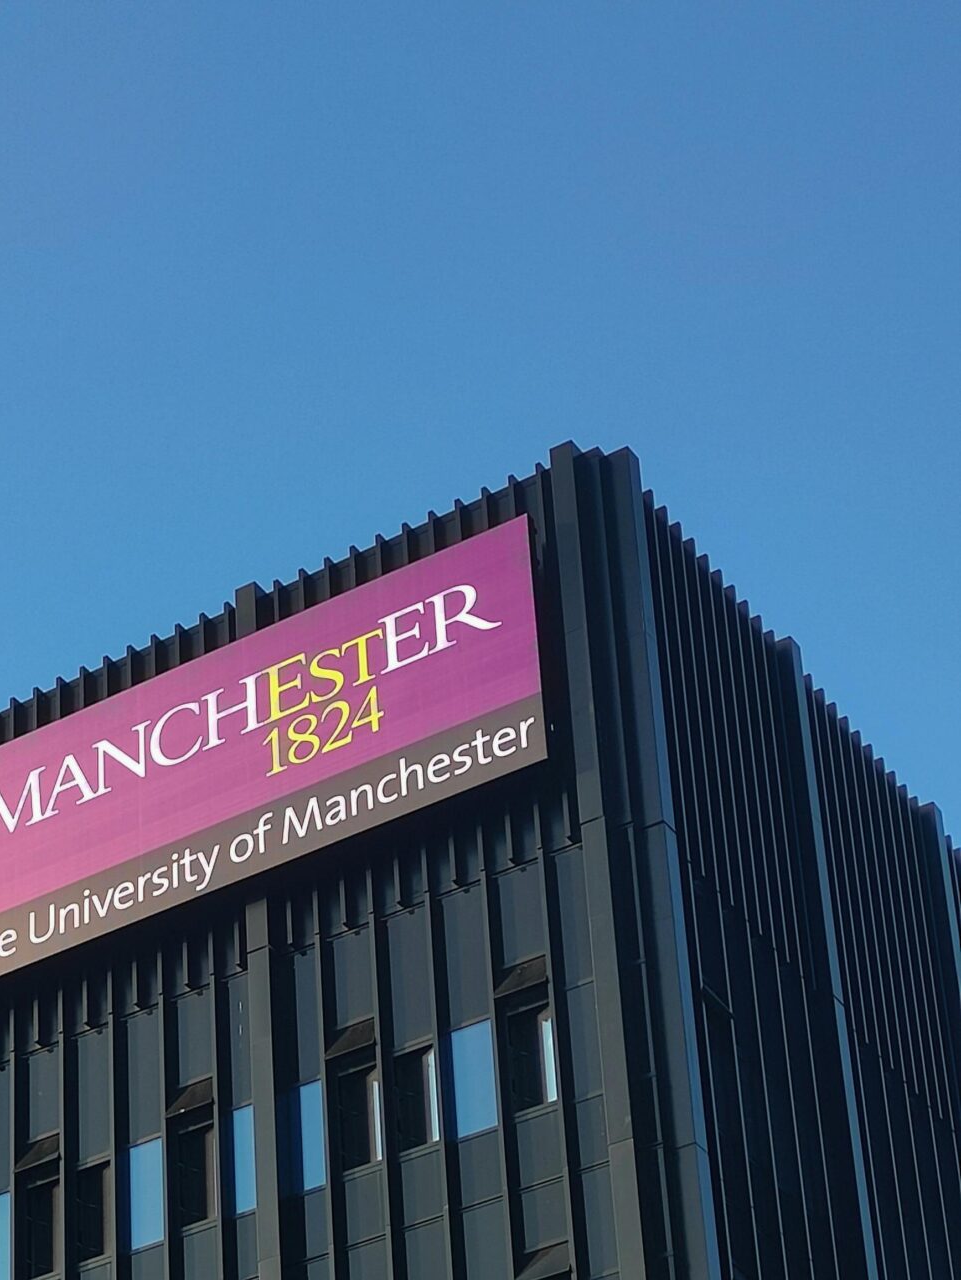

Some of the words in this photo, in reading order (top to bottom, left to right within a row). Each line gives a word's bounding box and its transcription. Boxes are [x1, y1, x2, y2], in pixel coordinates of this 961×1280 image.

[262, 686, 385, 777] 1824
[28, 843, 221, 944] University
[229, 811, 273, 863] of
[282, 717, 536, 845] Manchester
